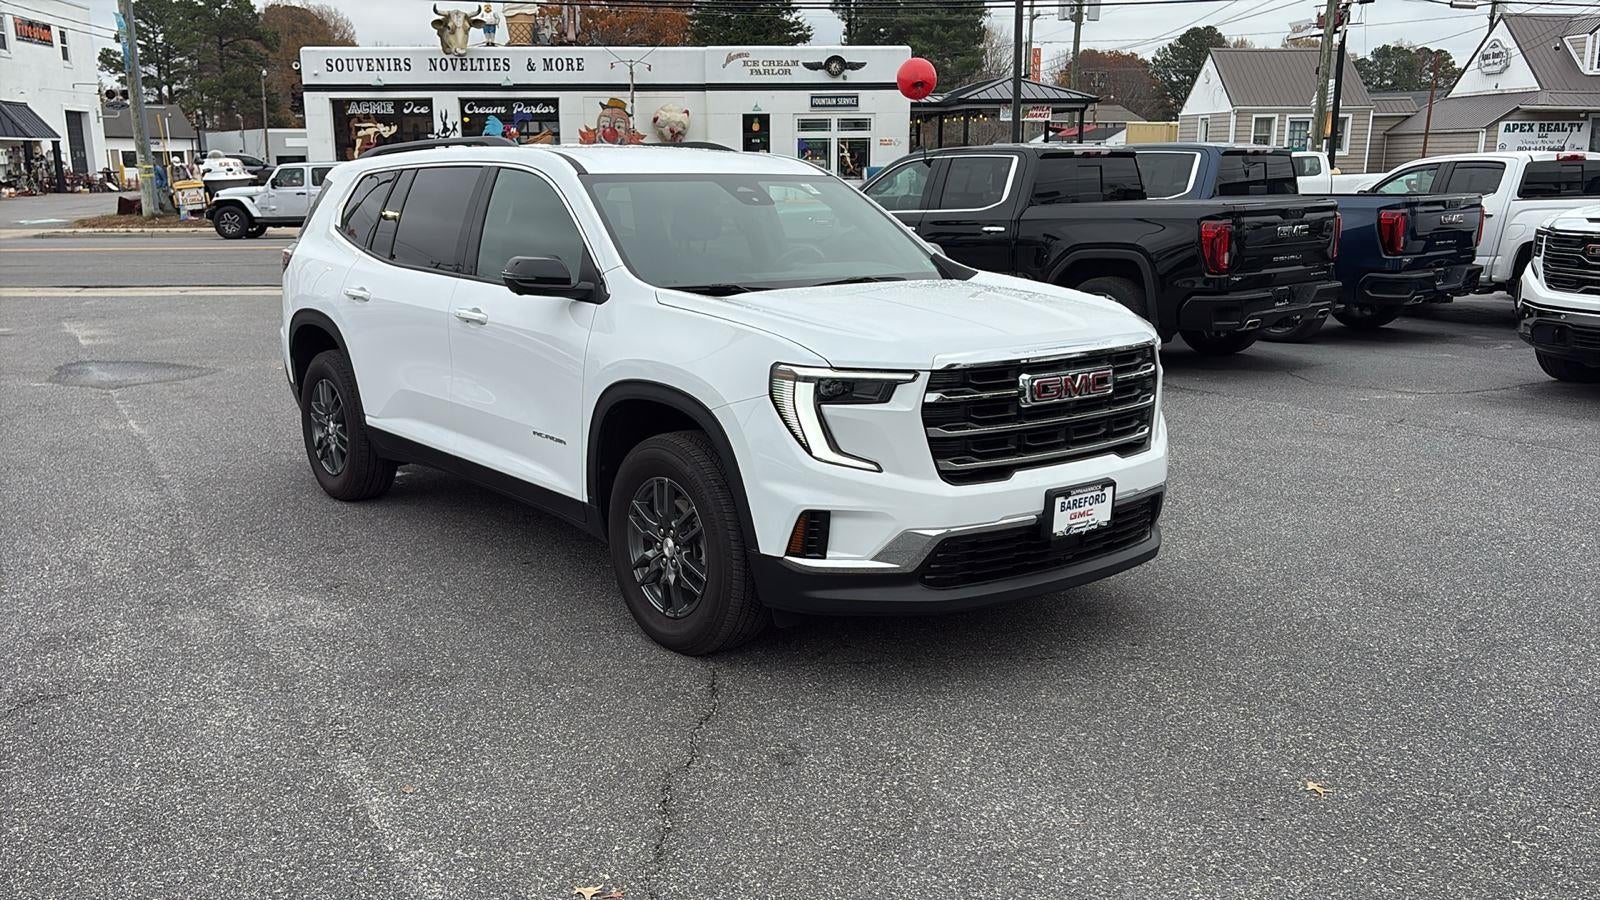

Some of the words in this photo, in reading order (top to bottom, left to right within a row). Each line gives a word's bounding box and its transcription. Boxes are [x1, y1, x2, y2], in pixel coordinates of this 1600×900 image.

[325, 58, 412, 72] SOUVENIRS
[428, 57, 511, 72] NOVELTIES
[526, 57, 537, 72] &
[542, 57, 585, 72] MORE
[750, 68, 792, 76] PARLOR
[464, 101, 507, 114] Cream
[512, 101, 556, 114] Parlor
[812, 97, 836, 105] FOUNTAIN
[837, 97, 858, 105] SERVICE
[346, 101, 395, 115] ACME
[403, 101, 431, 114] Ice
[1503, 122, 1535, 133] APEX
[1538, 122, 1584, 133] REALTY
[1277, 224, 1310, 238] GMC
[1033, 369, 1113, 401] GMC
[1060, 492, 1107, 513] BAREFORD
[1069, 508, 1094, 521] GMC
